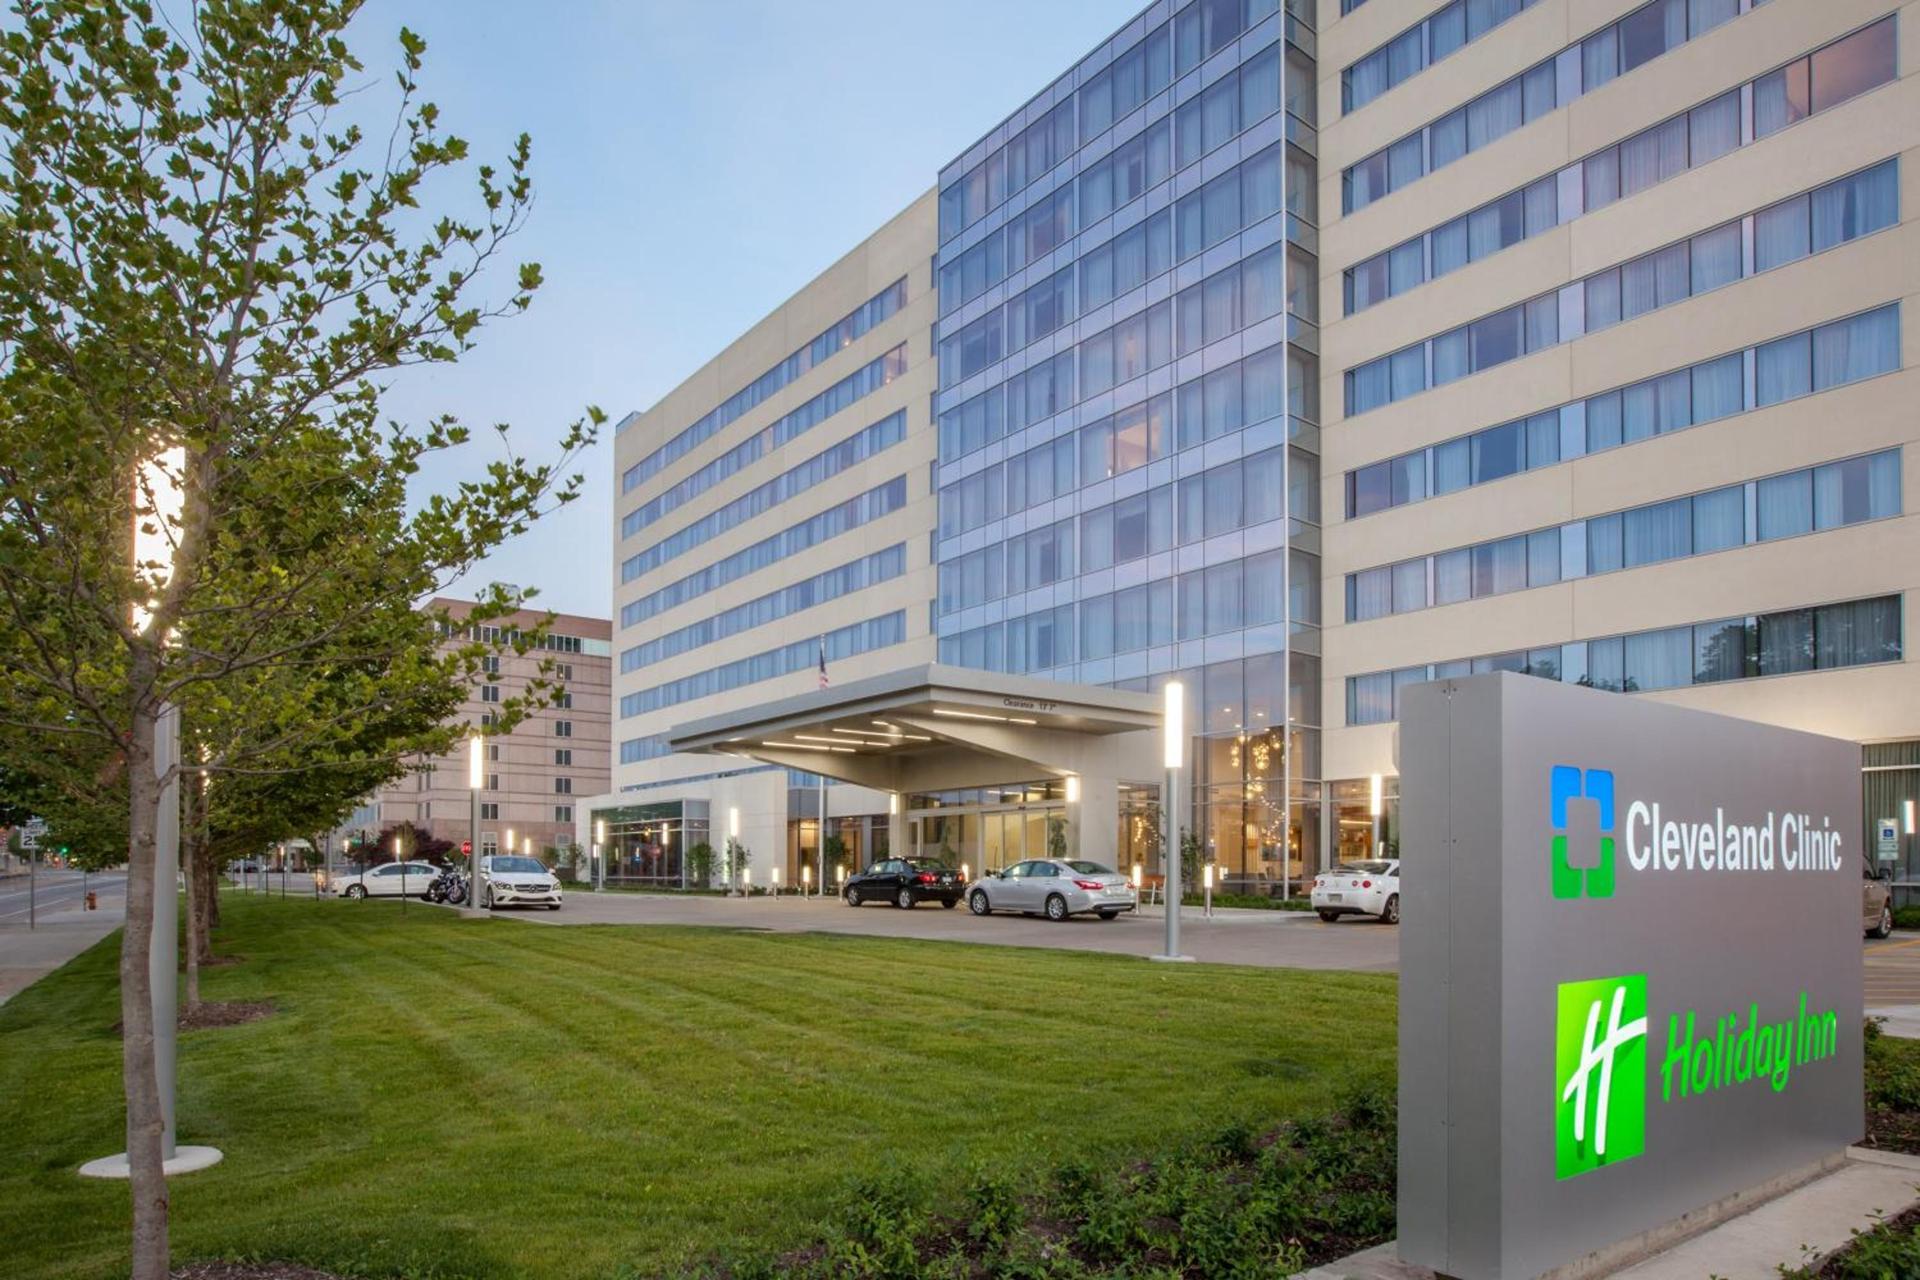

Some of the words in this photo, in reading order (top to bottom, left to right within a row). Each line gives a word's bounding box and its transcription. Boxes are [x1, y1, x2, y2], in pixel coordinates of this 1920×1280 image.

[1626, 800, 1774, 871] Cleveland
[1780, 812, 1842, 871] Clinic
[1660, 1003, 1793, 1102] Holiday
[1796, 991, 1837, 1066] Inn
